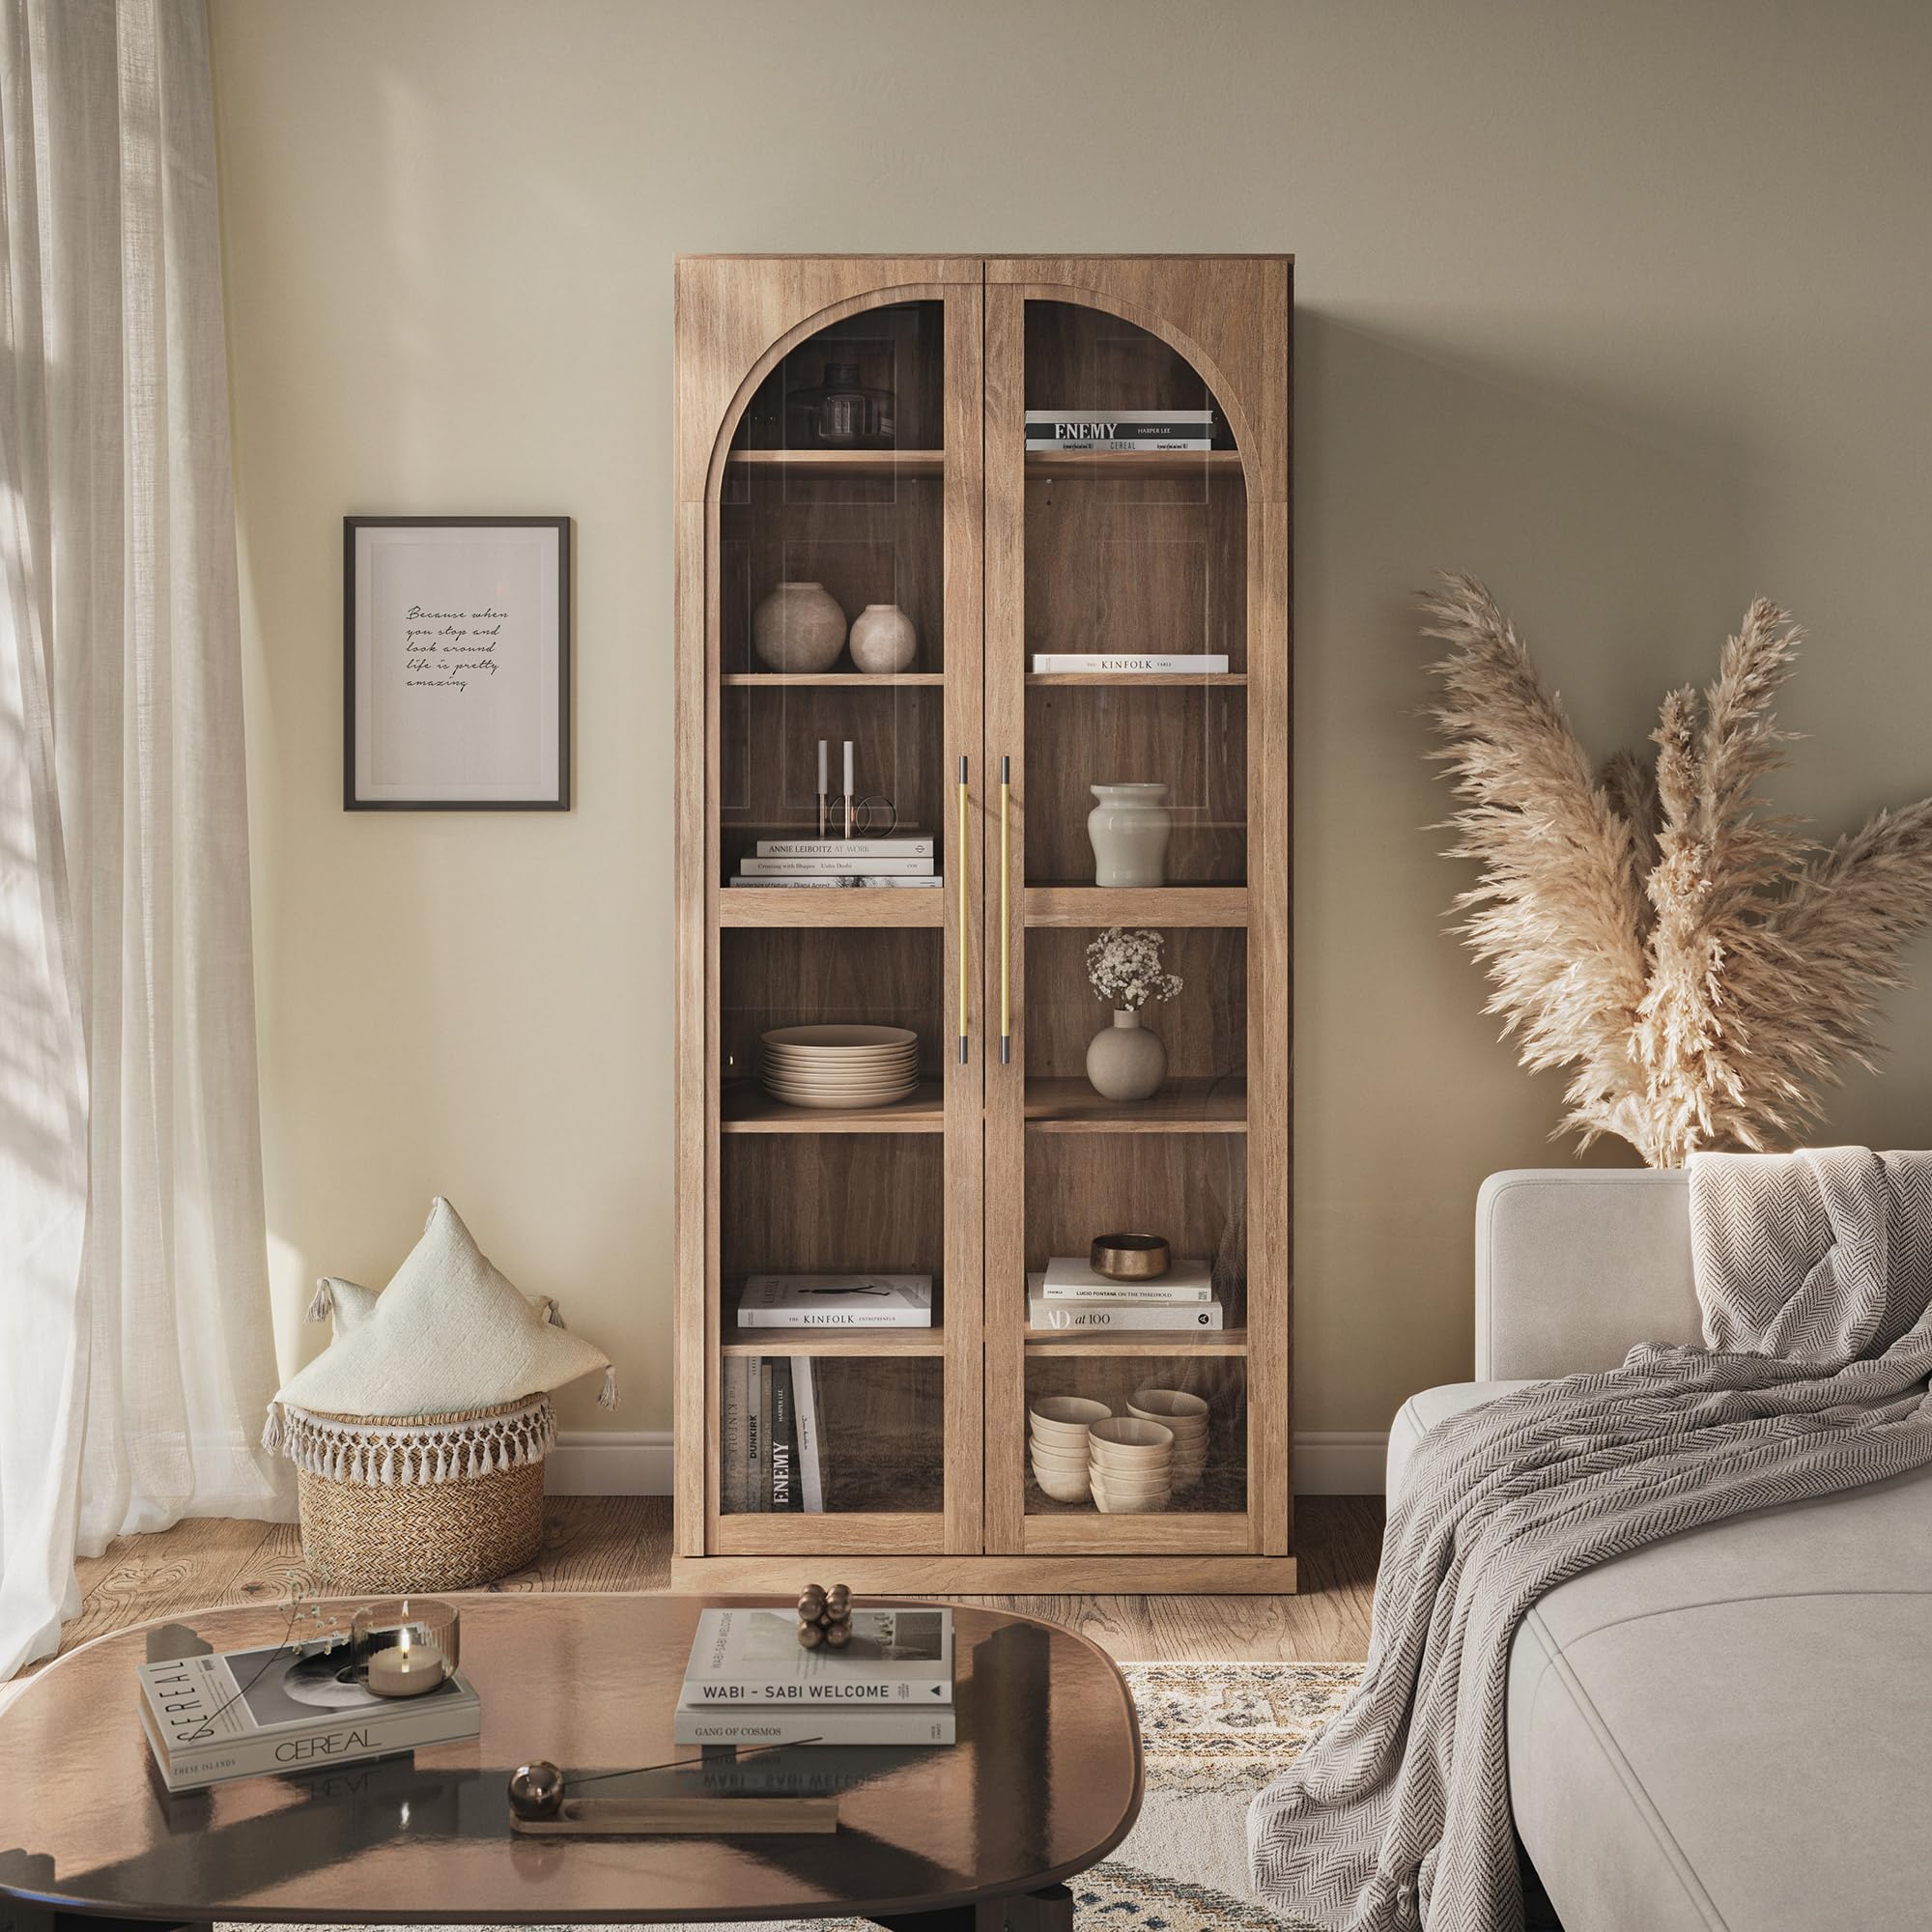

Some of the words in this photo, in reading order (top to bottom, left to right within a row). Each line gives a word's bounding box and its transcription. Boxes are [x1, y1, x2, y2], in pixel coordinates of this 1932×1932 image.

[1055, 423, 1118, 440] ENEMY
[1110, 441, 1136, 450] CEREAL
[406, 606, 467, 620] Because
[471, 608, 509, 619] when
[406, 629, 433, 641] you
[438, 625, 467, 641] stop
[472, 624, 500, 636] and
[406, 641, 437, 652] look
[442, 641, 497, 652] around
[406, 658, 432, 671] life
[437, 659, 450, 669] is
[452, 659, 499, 675] pretty
[1101, 660, 1152, 669] KINFOLK
[406, 676, 469, 693] amazing
[804, 1315, 854, 1323] KINFOLK
[1075, 1315, 1087, 1324] at
[1089, 1314, 1111, 1324] 100
[727, 1404, 737, 1456] KINFOLK
[773, 1441, 789, 1503] ENEMY
[703, 1686, 745, 1698] WABI
[765, 1686, 803, 1698] SABI
[809, 1685, 889, 1697] WELCOME
[149, 1662, 214, 1741] CEREAL
[695, 1727, 724, 1737] GANG
[724, 1727, 739, 1737] OF
[740, 1727, 781, 1736] COSMOS
[275, 1729, 382, 1763] CEREAL
